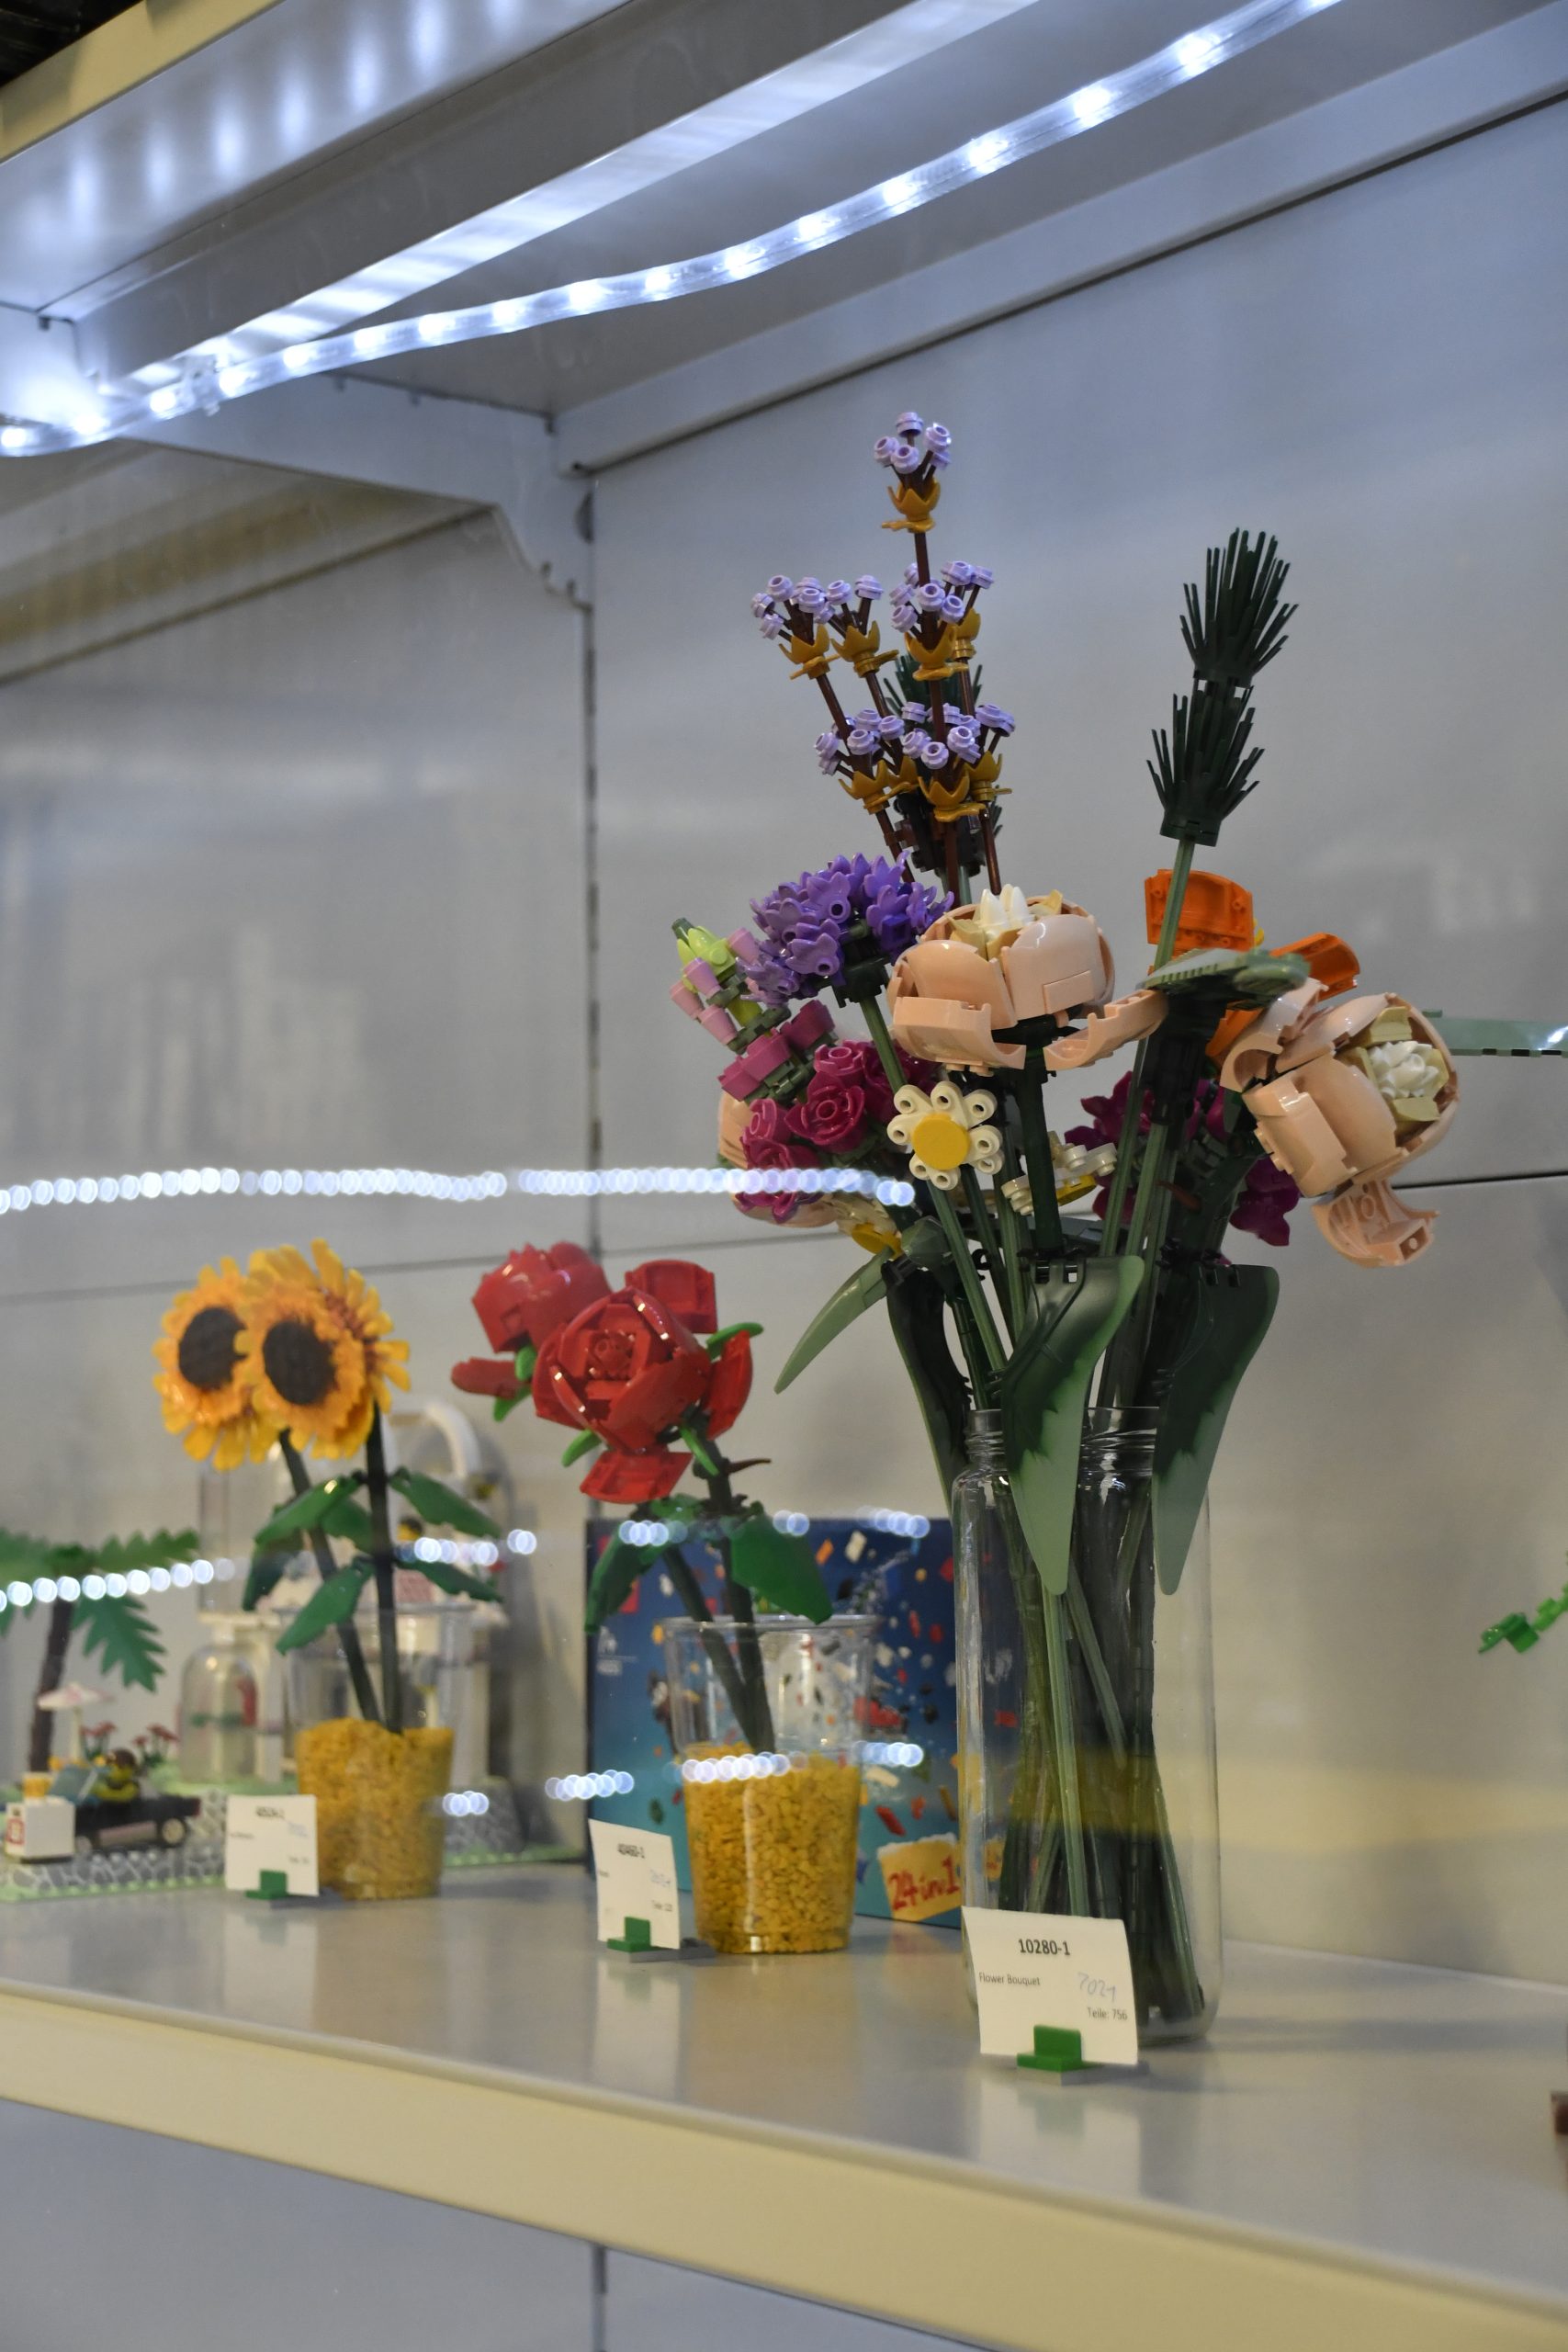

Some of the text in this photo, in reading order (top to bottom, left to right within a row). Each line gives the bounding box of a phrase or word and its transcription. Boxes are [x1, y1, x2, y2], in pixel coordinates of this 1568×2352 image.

[1018, 1938, 1070, 1956] 10280-1
[978, 1972, 1041, 1986] Flower Bouquet
[1087, 2007, 1128, 2021] Teile: 756
